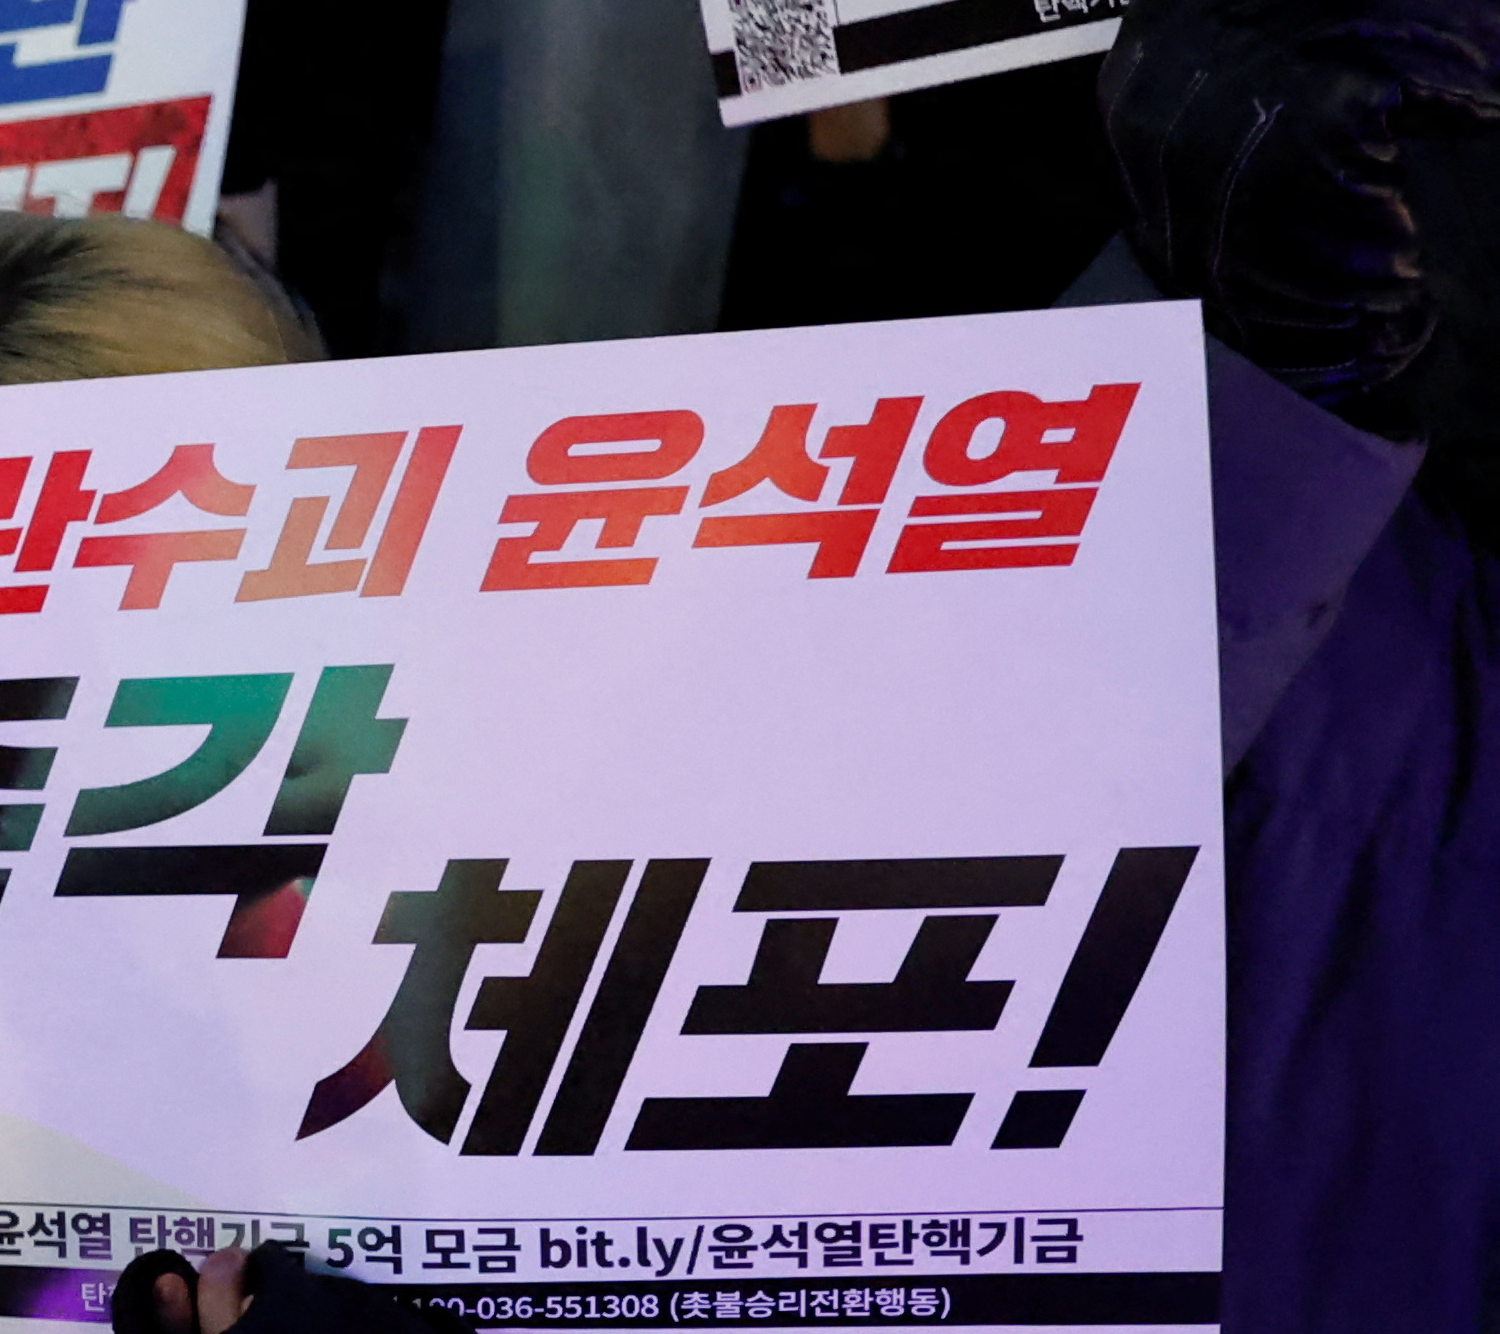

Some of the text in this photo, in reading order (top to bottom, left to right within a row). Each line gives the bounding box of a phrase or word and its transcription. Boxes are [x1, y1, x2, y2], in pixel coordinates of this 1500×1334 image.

[479, 381, 1142, 592] 윤석열
[296, 845, 1201, 1158] 체포!
[326, 1225, 402, 1276] 5억
[422, 1225, 521, 1274] 모금
[539, 1217, 1084, 1278] bit.ly/윤석열탄핵기금
[669, 1287, 952, 1323] (촛불승리전환행동)
